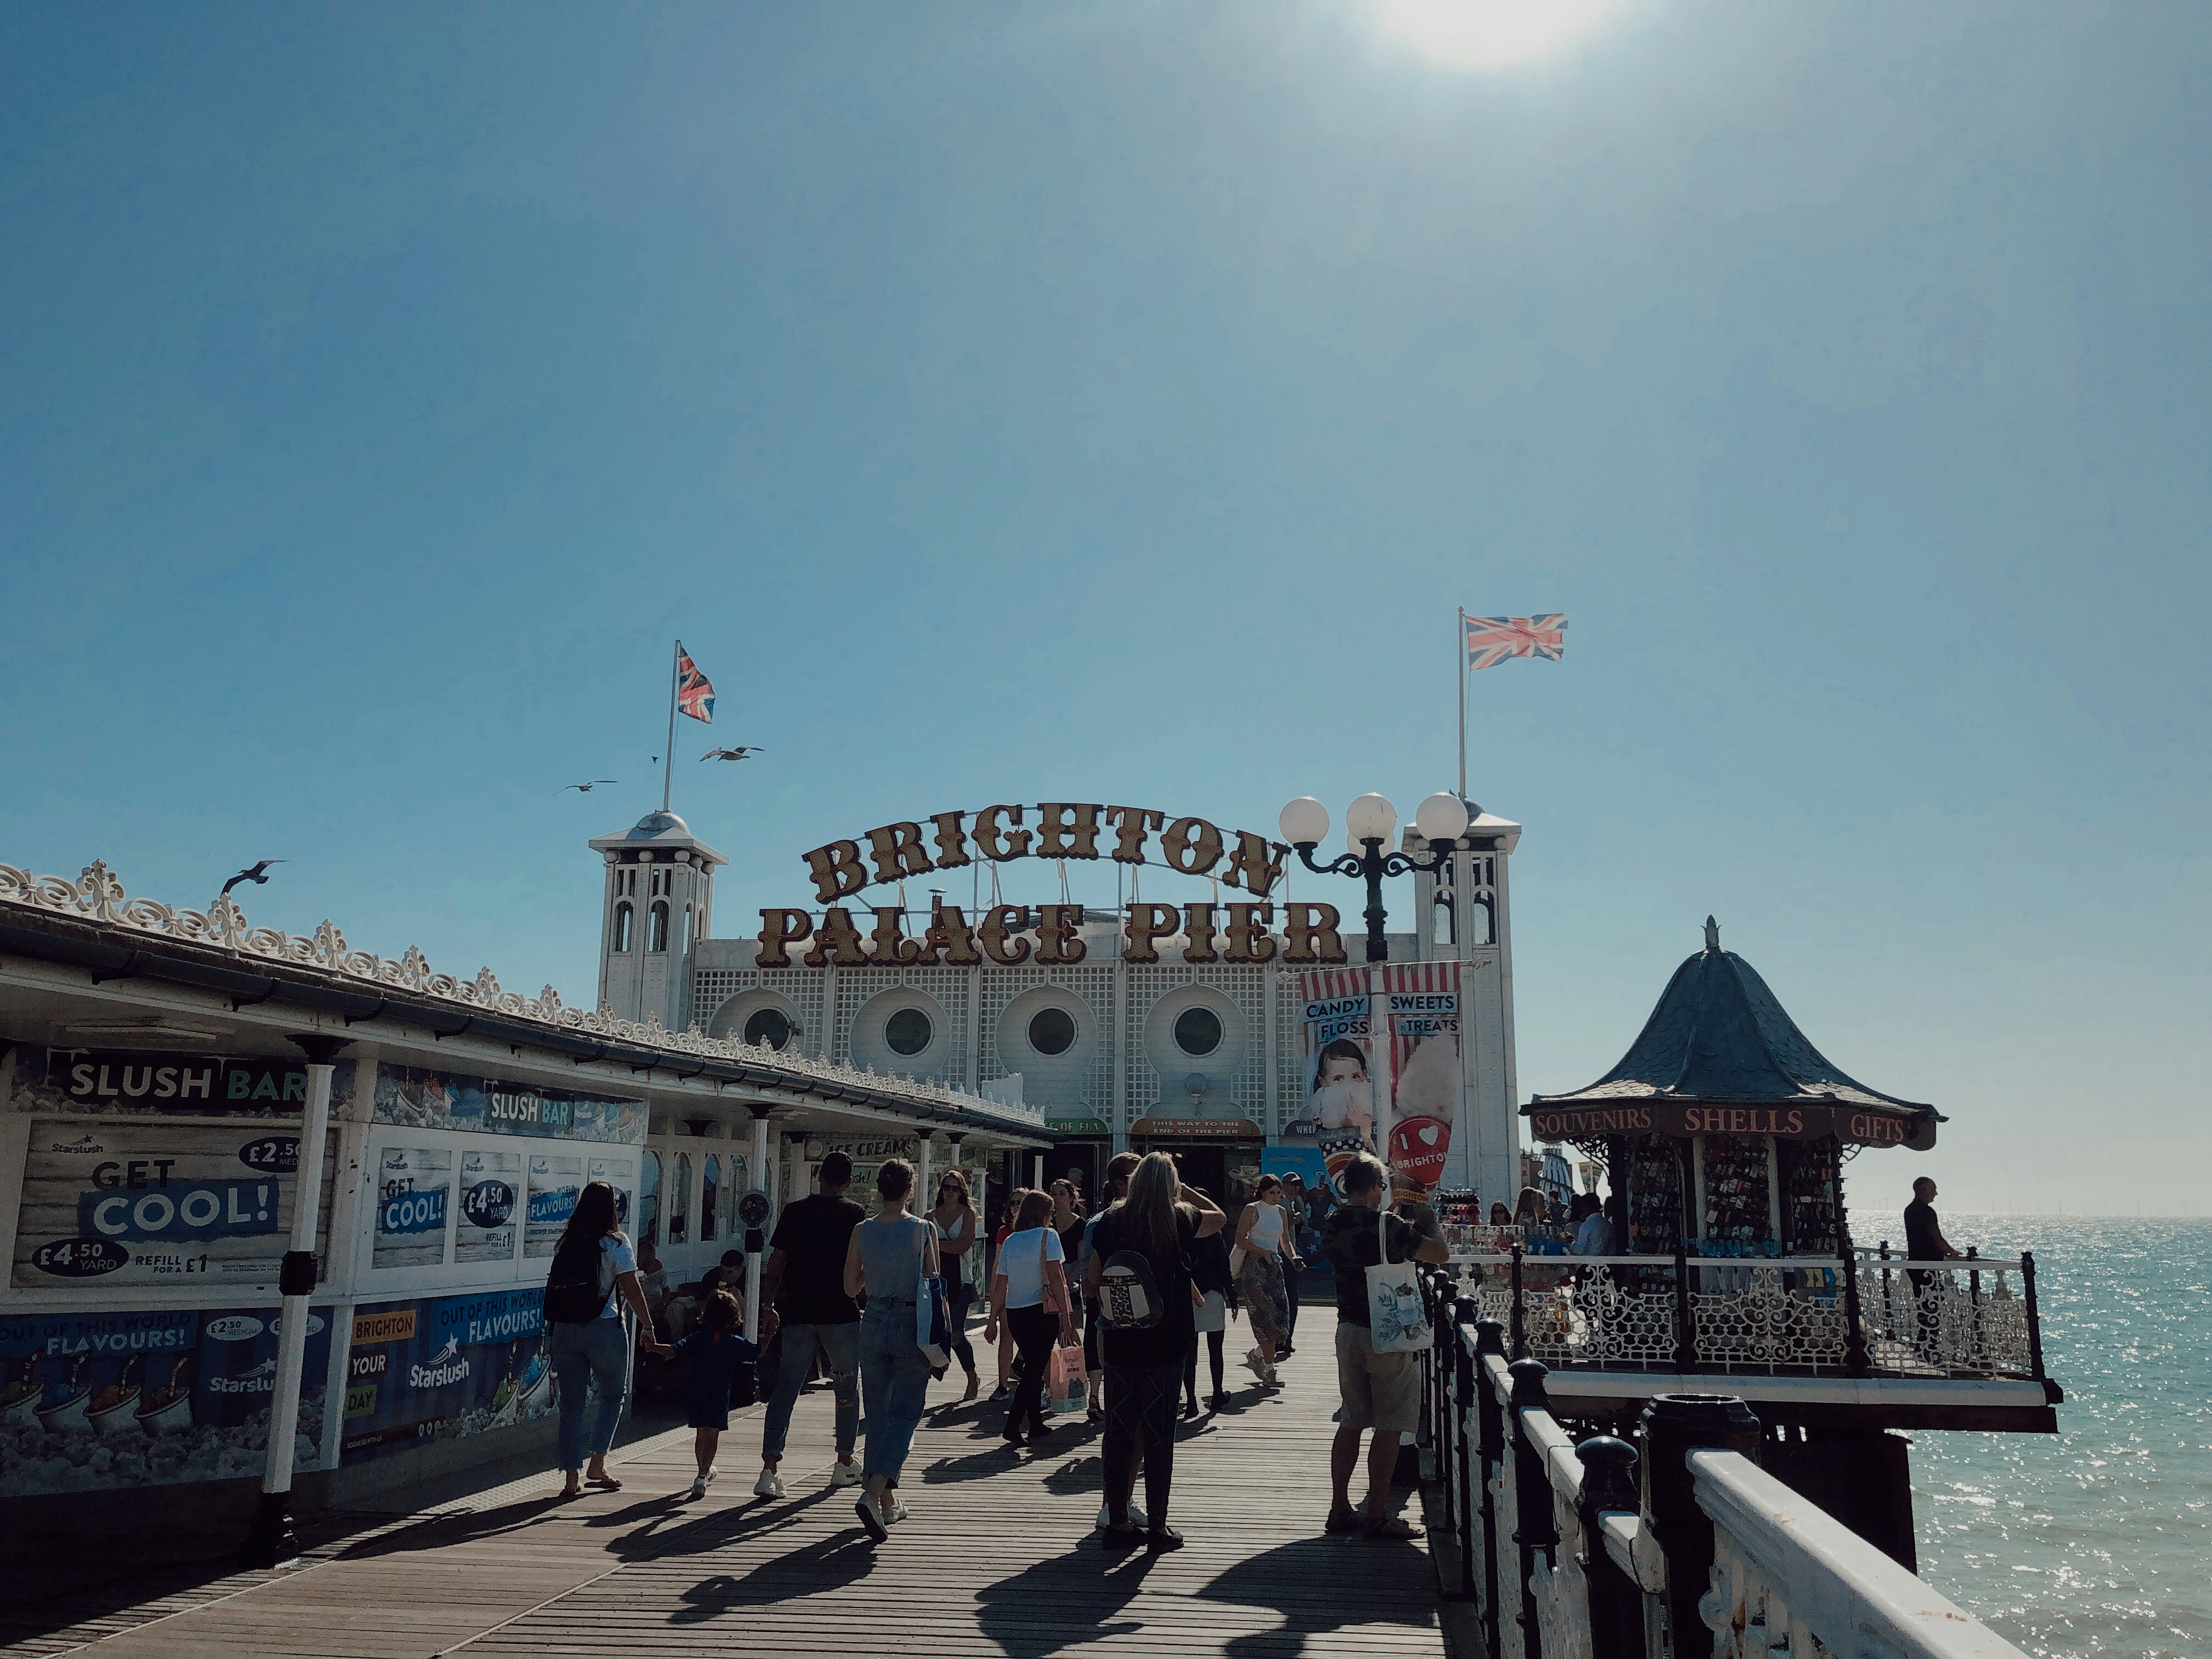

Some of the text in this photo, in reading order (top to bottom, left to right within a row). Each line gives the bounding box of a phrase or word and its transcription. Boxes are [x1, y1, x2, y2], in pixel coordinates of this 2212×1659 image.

[802, 803, 1292, 905] BRIGHTON
[755, 902, 1347, 968] PALACE PIER
[1306, 998, 1365, 1019] CANDY
[1391, 995, 1454, 1010] SWEETS
[1321, 1020, 1368, 1038] FLOSS
[1406, 1019, 1458, 1031] TREATS
[70, 1064, 307, 1102] SLUSH BAR
[491, 1093, 568, 1125] SLUSH BAR
[1536, 1107, 1652, 1134] SOUVENIRS
[1684, 1108, 1803, 1133] SHELLS
[1060, 1122, 1074, 1131] OF
[1079, 1122, 1101, 1131] FUN
[1850, 1114, 1904, 1142] GIFTS
[1400, 1133, 1409, 1150] I
[92, 1159, 175, 1190] GET
[386, 1177, 414, 1200] GET
[93, 1186, 268, 1234] COOL!
[386, 1194, 443, 1229] COOL!
[468, 1187, 503, 1214] £4.50
[531, 1195, 576, 1218] FLAVOURS!
[490, 1206, 509, 1219] YARD
[486, 1233, 502, 1242] REFILL
[40, 1243, 103, 1265] £4.50
[80, 1260, 116, 1271] YARD
[136, 1255, 182, 1266] REFILL
[185, 1254, 207, 1273] £1
[441, 1289, 545, 1326] OUT OF THIS WORLD
[43, 1323, 69, 1337] OF
[75, 1318, 117, 1334] THIS
[123, 1312, 191, 1330] WORLD
[211, 1321, 241, 1333] £2.50
[356, 1316, 413, 1339] BRIGHTON
[469, 1308, 540, 1344] FLAVOURS!
[47, 1328, 186, 1356] FLAVOURS!
[353, 1354, 386, 1375] YOUR
[410, 1357, 469, 1388] Starslush
[210, 1376, 274, 1392] Starslu
[348, 1391, 373, 1412] DAY
